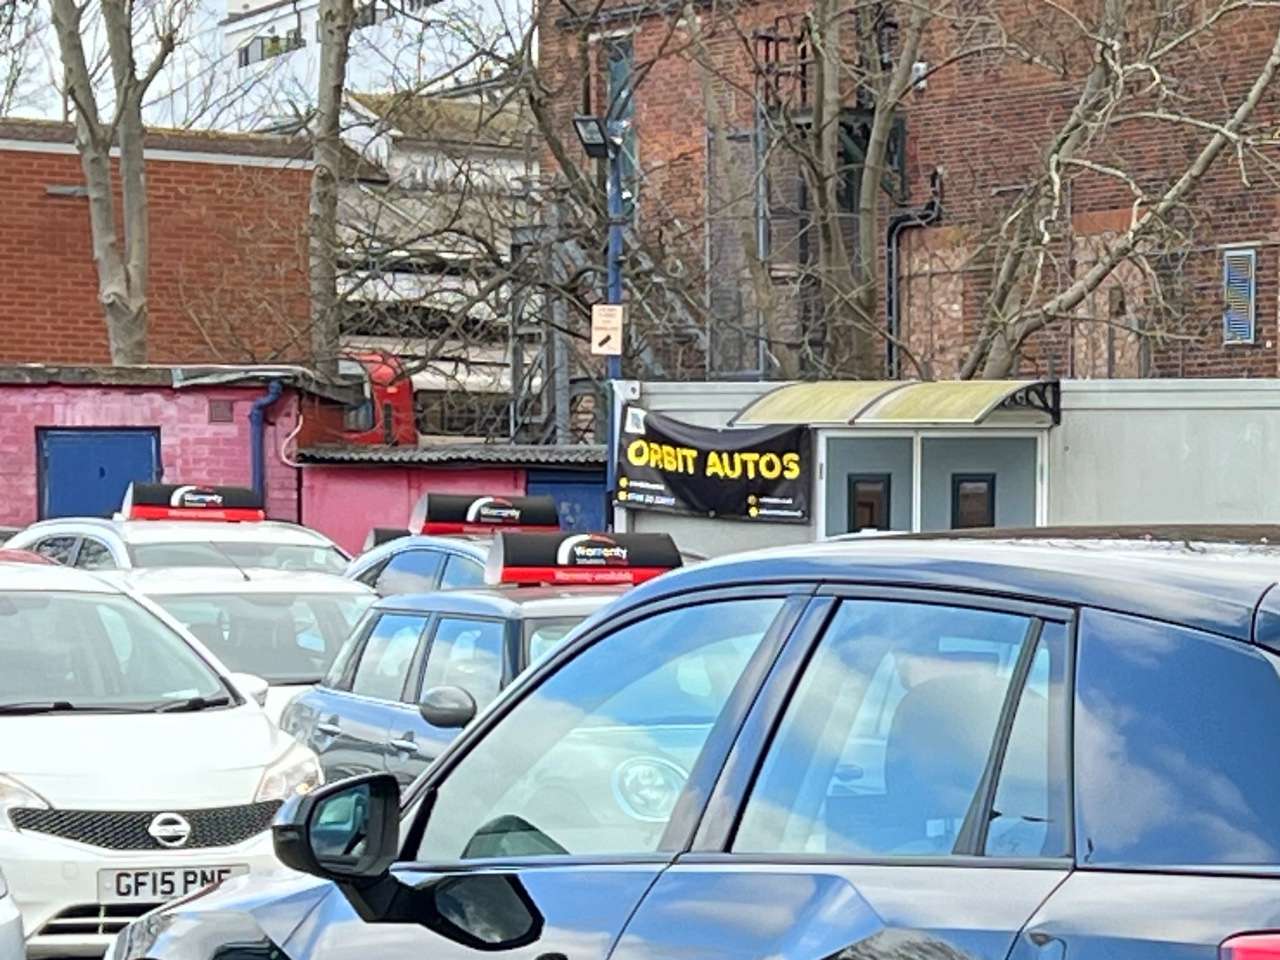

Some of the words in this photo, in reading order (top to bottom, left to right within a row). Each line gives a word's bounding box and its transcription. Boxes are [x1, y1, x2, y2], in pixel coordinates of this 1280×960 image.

[628, 439, 698, 475] ORBIT
[706, 452, 800, 480] AUTOS
[116, 871, 175, 896] GF15
